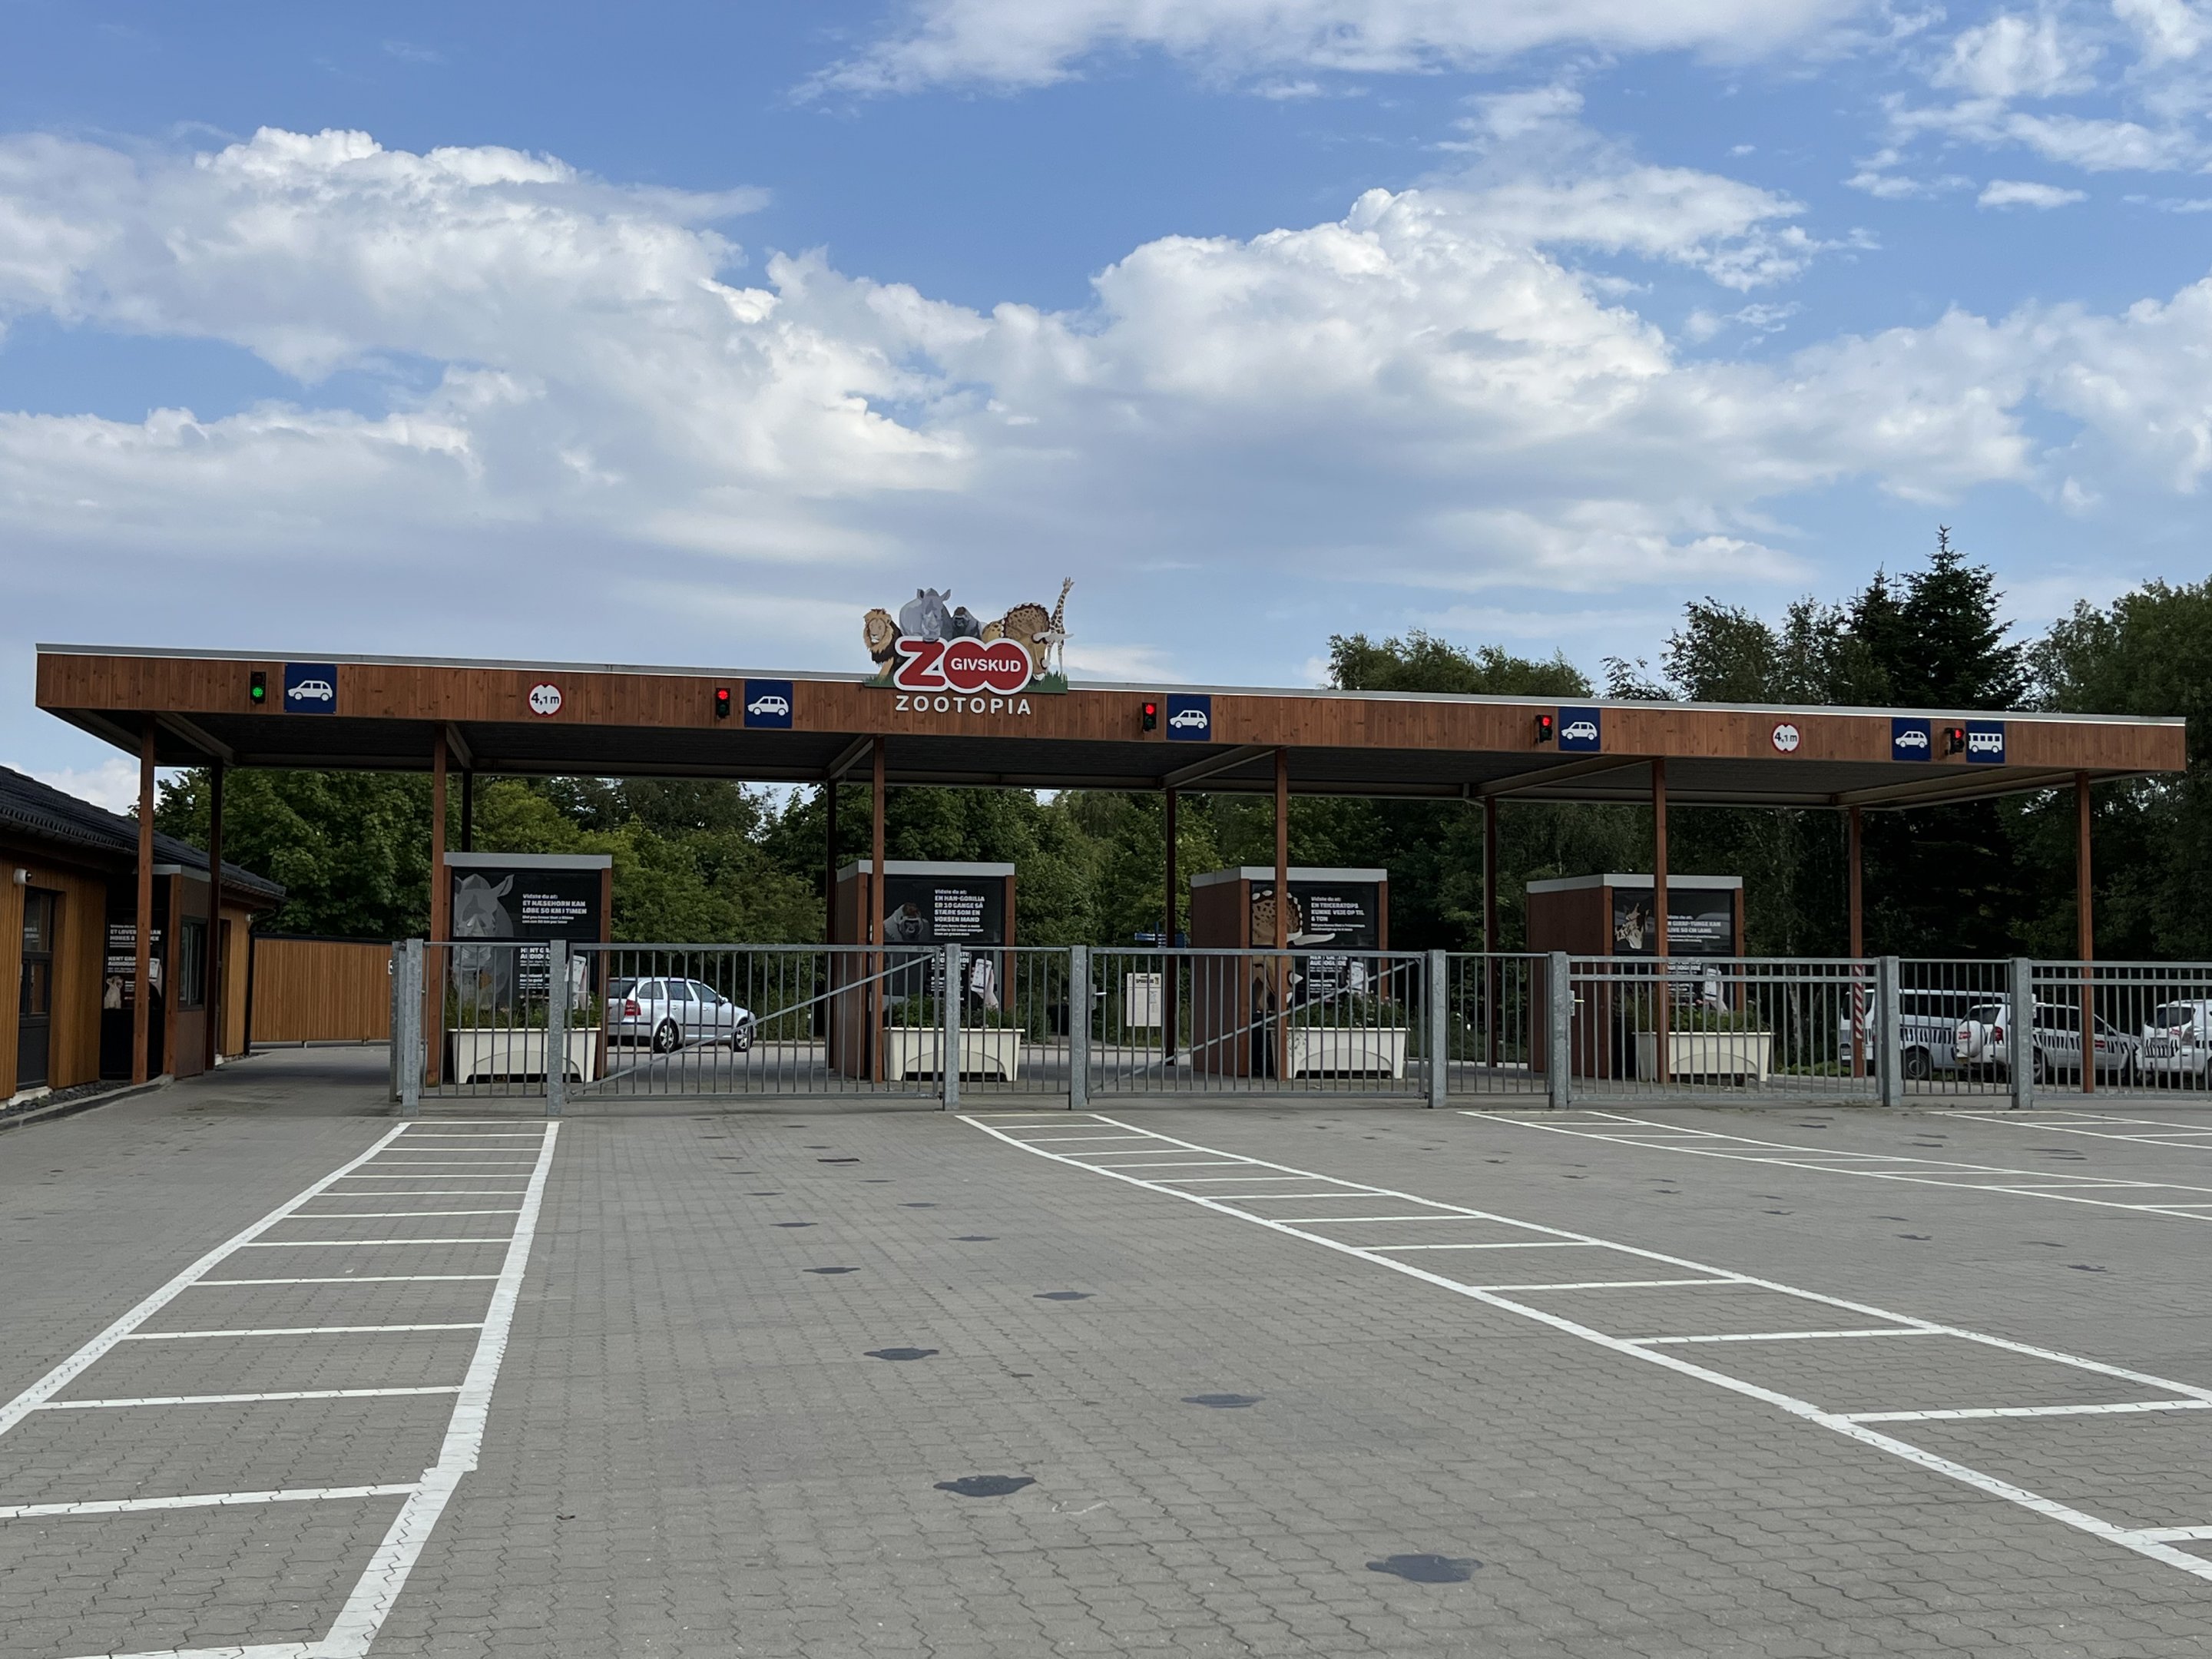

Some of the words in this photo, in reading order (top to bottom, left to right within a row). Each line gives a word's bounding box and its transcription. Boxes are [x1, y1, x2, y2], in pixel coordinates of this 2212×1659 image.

[899, 641, 1029, 690] ZOO
[951, 658, 1022, 673] GIVSKUD
[895, 695, 1031, 715] ZOOTOPIA
